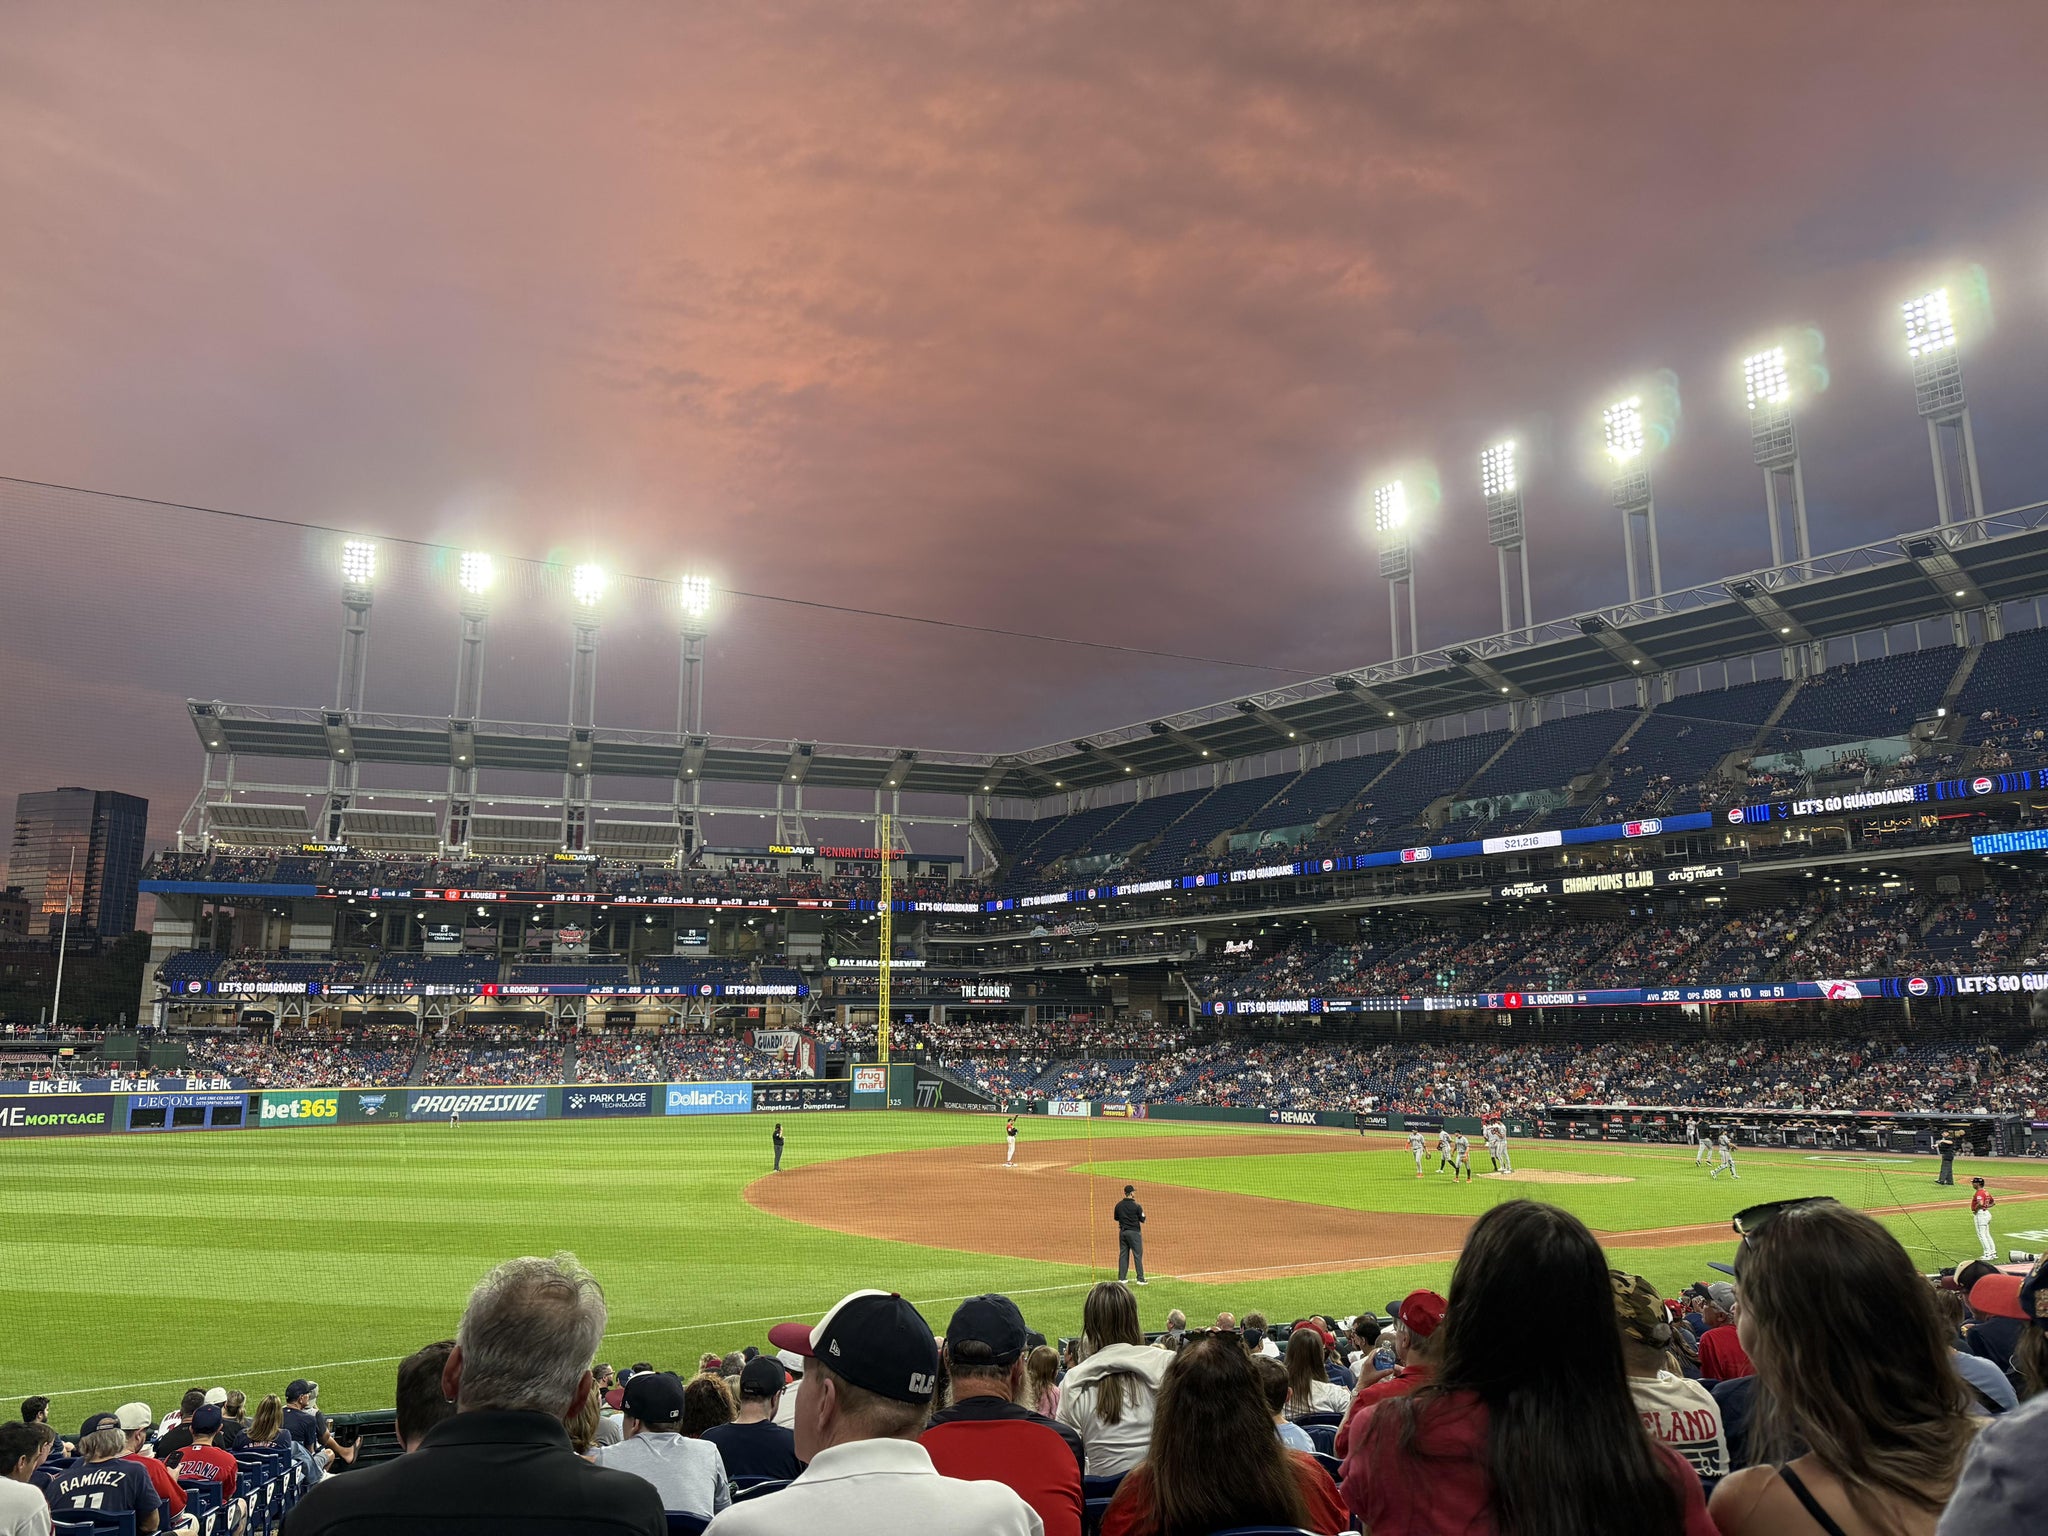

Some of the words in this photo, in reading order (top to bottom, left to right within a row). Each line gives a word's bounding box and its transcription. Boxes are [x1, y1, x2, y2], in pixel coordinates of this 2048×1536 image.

[1793, 799, 1823, 816] LET'S
[1825, 797, 1842, 812] GO
[1843, 787, 1914, 810] GUARDIANS!
[1504, 837, 1539, 849] $21,216
[819, 846, 862, 858] PENNANT
[1668, 871, 1694, 882] drug
[1695, 866, 1723, 878] mart
[1563, 874, 1622, 894] CHAMPIONS
[1625, 870, 1654, 888] CLUB
[1501, 887, 1523, 897] drug
[1524, 884, 1548, 895] mart
[218, 982, 242, 993] LET'S
[243, 982, 255, 993] GO
[725, 985, 745, 995] LET'S
[746, 985, 755, 995] GO
[1956, 976, 1997, 993] LET'S
[1998, 975, 2020, 992] GO
[961, 985, 976, 997] THE
[978, 985, 1010, 998] CORNER
[1660, 990, 1680, 1001] .252
[1687, 992, 1700, 1000] OPS
[1701, 989, 1722, 999] .688
[1740, 987, 1751, 998] 10
[1760, 990, 1771, 998] RBI
[1774, 986, 1784, 997] 51
[1528, 996, 1536, 1005] B.
[1537, 993, 1574, 1004] ROCCHIO
[1236, 1002, 1256, 1013] LET'S
[1256, 1001, 1266, 1012] GO
[758, 1036, 782, 1050] GUARDS
[857, 1068, 881, 1083] drug
[28, 1080, 83, 1094] Elk+Elk
[110, 1079, 161, 1092] Elk+Elk
[186, 1078, 232, 1091] Elk+Elk
[411, 1094, 543, 1113] PROGRESSIVE
[589, 1093, 614, 1103] PARK
[616, 1093, 646, 1103] PLACE
[261, 1098, 338, 1119] bet365
[1058, 1102, 1079, 1115] ROSE
[25, 1112, 105, 1126] MORTGAGE
[908, 1372, 935, 1394] CLE
[1641, 1409, 1717, 1442] ELAND
[179, 1460, 220, 1480] ZZANA
[60, 1468, 126, 1495] RAMÍREZ
[71, 1492, 104, 1509] 11
